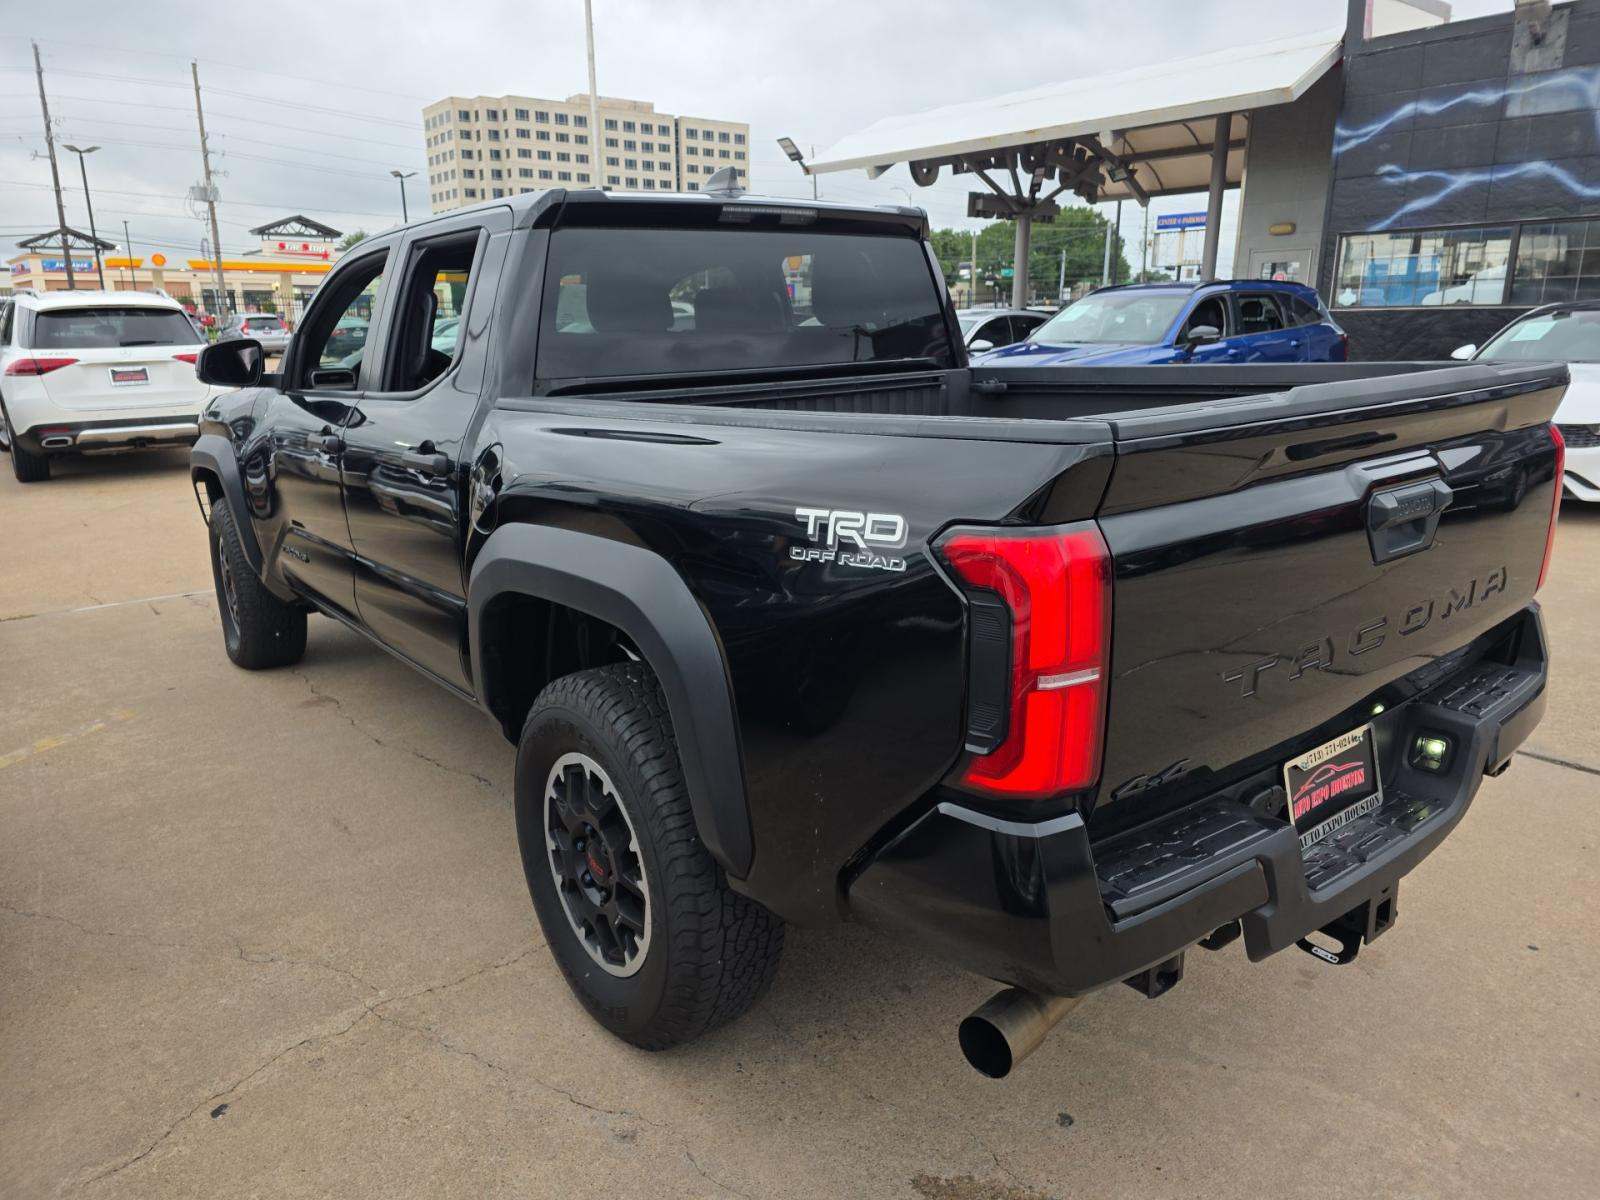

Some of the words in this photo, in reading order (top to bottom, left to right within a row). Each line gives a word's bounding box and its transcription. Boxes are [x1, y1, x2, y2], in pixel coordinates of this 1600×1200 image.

[795, 507, 907, 551] TRD
[789, 546, 835, 564] OFF
[838, 552, 907, 572] ROAD
[1222, 566, 1508, 698] TACOMA
[1322, 815, 1343, 838] EXPO
[1344, 794, 1381, 822] HOUSTON
